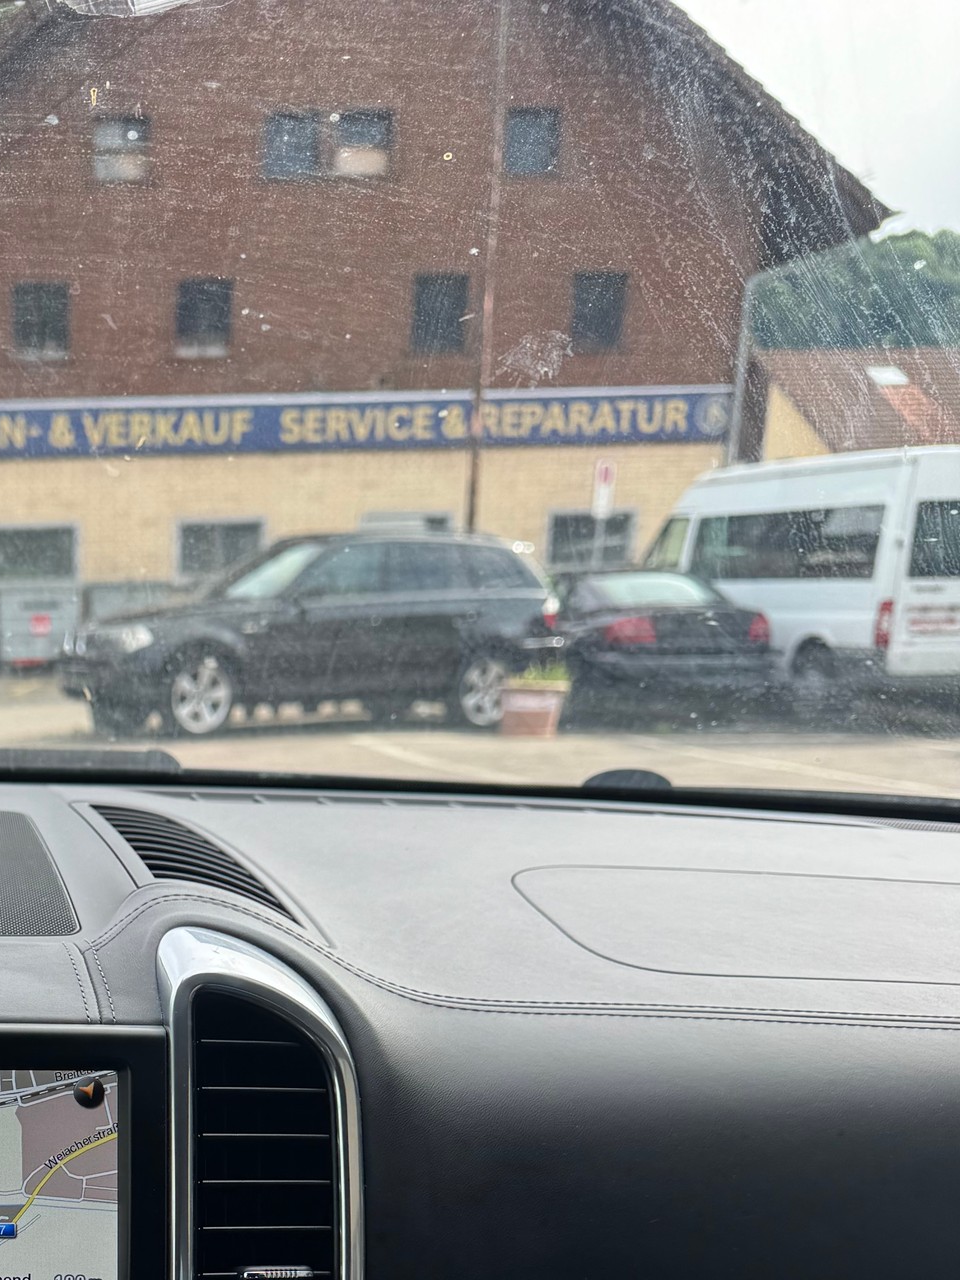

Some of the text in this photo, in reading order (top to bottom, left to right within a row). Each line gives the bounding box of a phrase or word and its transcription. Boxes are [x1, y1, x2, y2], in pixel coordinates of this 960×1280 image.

[48, 412, 76, 448] &
[81, 409, 254, 447] VERKAUF
[279, 405, 435, 443] SERVICE
[441, 408, 467, 439] &
[479, 399, 688, 438] REPARATUR
[0, 1225, 6, 1235] 7
